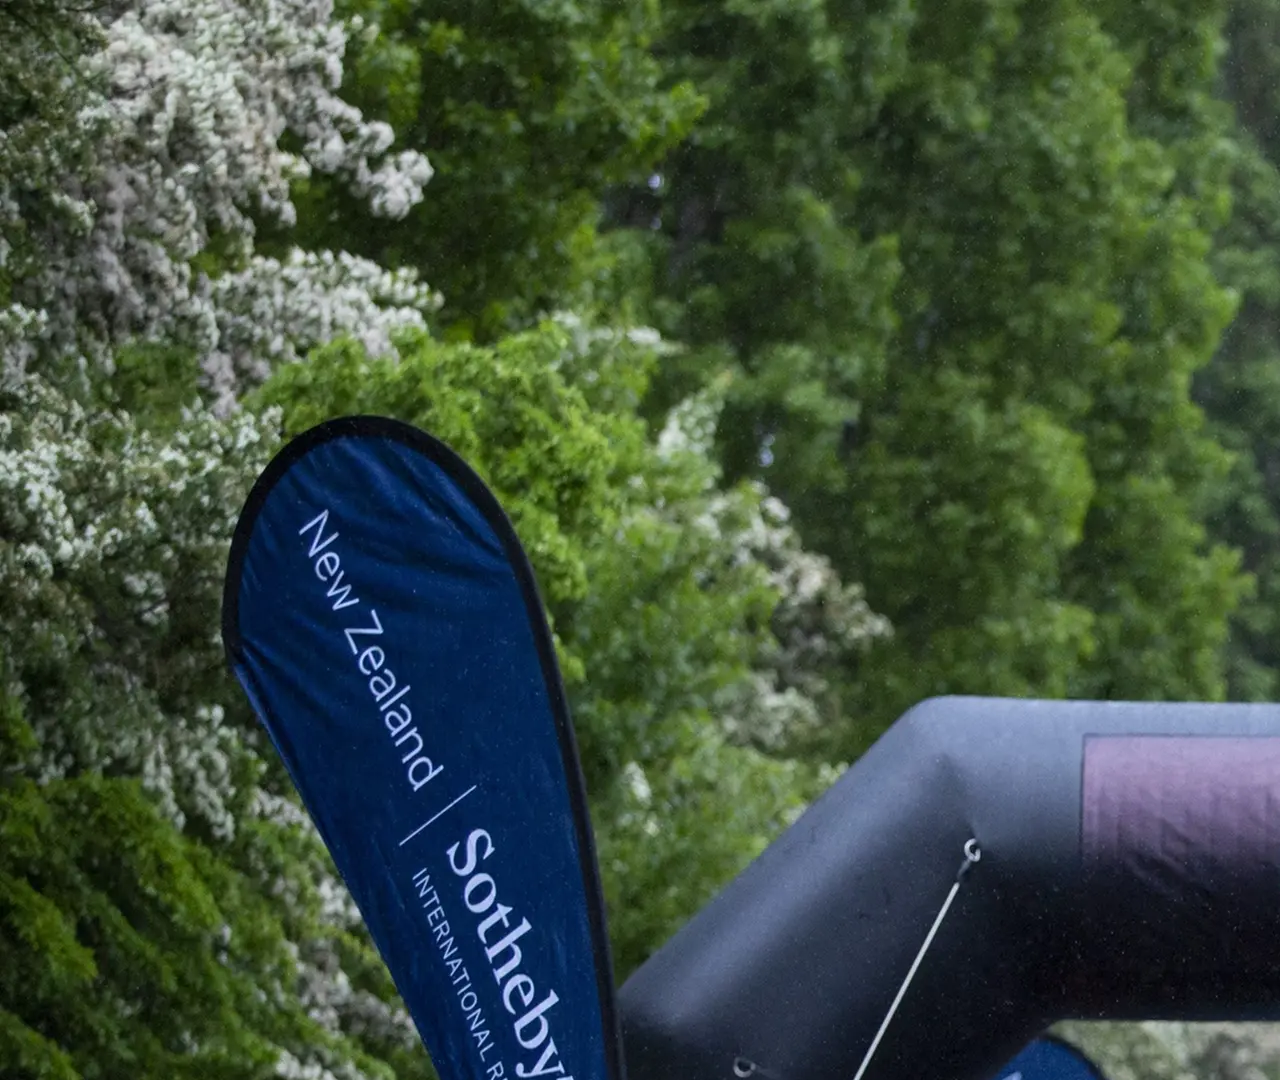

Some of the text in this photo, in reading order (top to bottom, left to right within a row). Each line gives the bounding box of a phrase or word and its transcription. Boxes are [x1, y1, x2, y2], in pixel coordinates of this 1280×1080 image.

[297, 508, 444, 792] New Zealand
[411, 867, 492, 1065] INTERNATIONAL
